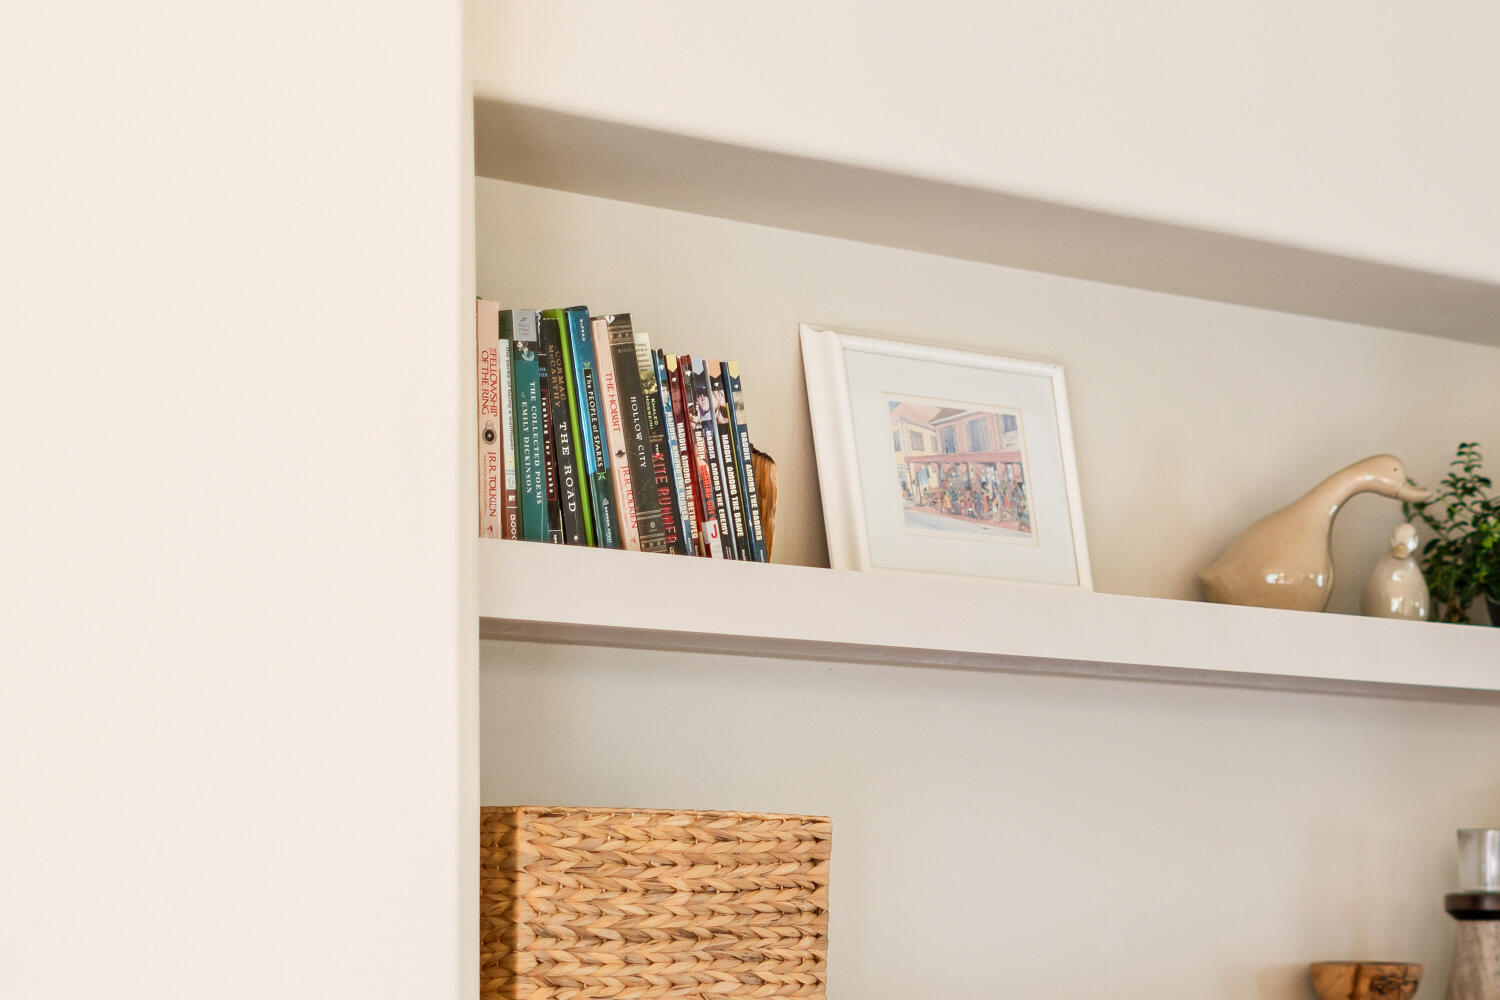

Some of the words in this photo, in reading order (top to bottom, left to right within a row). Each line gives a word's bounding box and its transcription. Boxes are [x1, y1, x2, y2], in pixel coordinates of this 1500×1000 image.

[481, 350, 489, 362] OF
[481, 362, 490, 379] THE
[489, 352, 498, 418] FELLOWSHIP
[555, 351, 567, 400] CORMAC
[585, 373, 593, 389] The
[604, 373, 615, 391] THE
[482, 381, 490, 415] RING
[587, 390, 598, 423] PEOPLE
[521, 401, 530, 432] EMILY
[609, 394, 621, 433] HOBBIT
[531, 405, 541, 467] COLLECTED
[558, 421, 570, 456] THE
[591, 424, 599, 434] of
[630, 396, 643, 441] HOLLOW
[637, 445, 647, 469] CITY
[677, 422, 687, 452] HADDIX
[592, 434, 604, 468] SPARKS
[694, 430, 704, 461] HADDIX
[706, 430, 715, 459] HADDIX
[721, 434, 731, 464] HADDIX
[740, 432, 750, 461] HADDIX
[523, 437, 533, 494] DICKINSON
[652, 452, 667, 485] KITE
[666, 411, 676, 441] HADDIX
[672, 445, 681, 475] AMONG
[679, 493, 689, 521] HIDDEN
[681, 455, 690, 484] AMONG
[710, 462, 720, 492] AMONG
[745, 463, 756, 493] AMONG
[488, 474, 497, 517] TOLKIEN
[535, 471, 543, 505] POEMS
[563, 464, 577, 513] ROAD
[684, 486, 692, 500] THE
[726, 466, 736, 496] AMONG
[715, 492, 723, 508] THE
[731, 496, 739, 511] THE
[750, 494, 758, 508] THE
[656, 487, 677, 544] RUNNER
[687, 501, 698, 540] BETRAYED
[718, 508, 728, 536] ENEMY
[734, 512, 744, 537] BRAVE
[752, 509, 763, 541] BARONS
[711, 524, 718, 539] J
